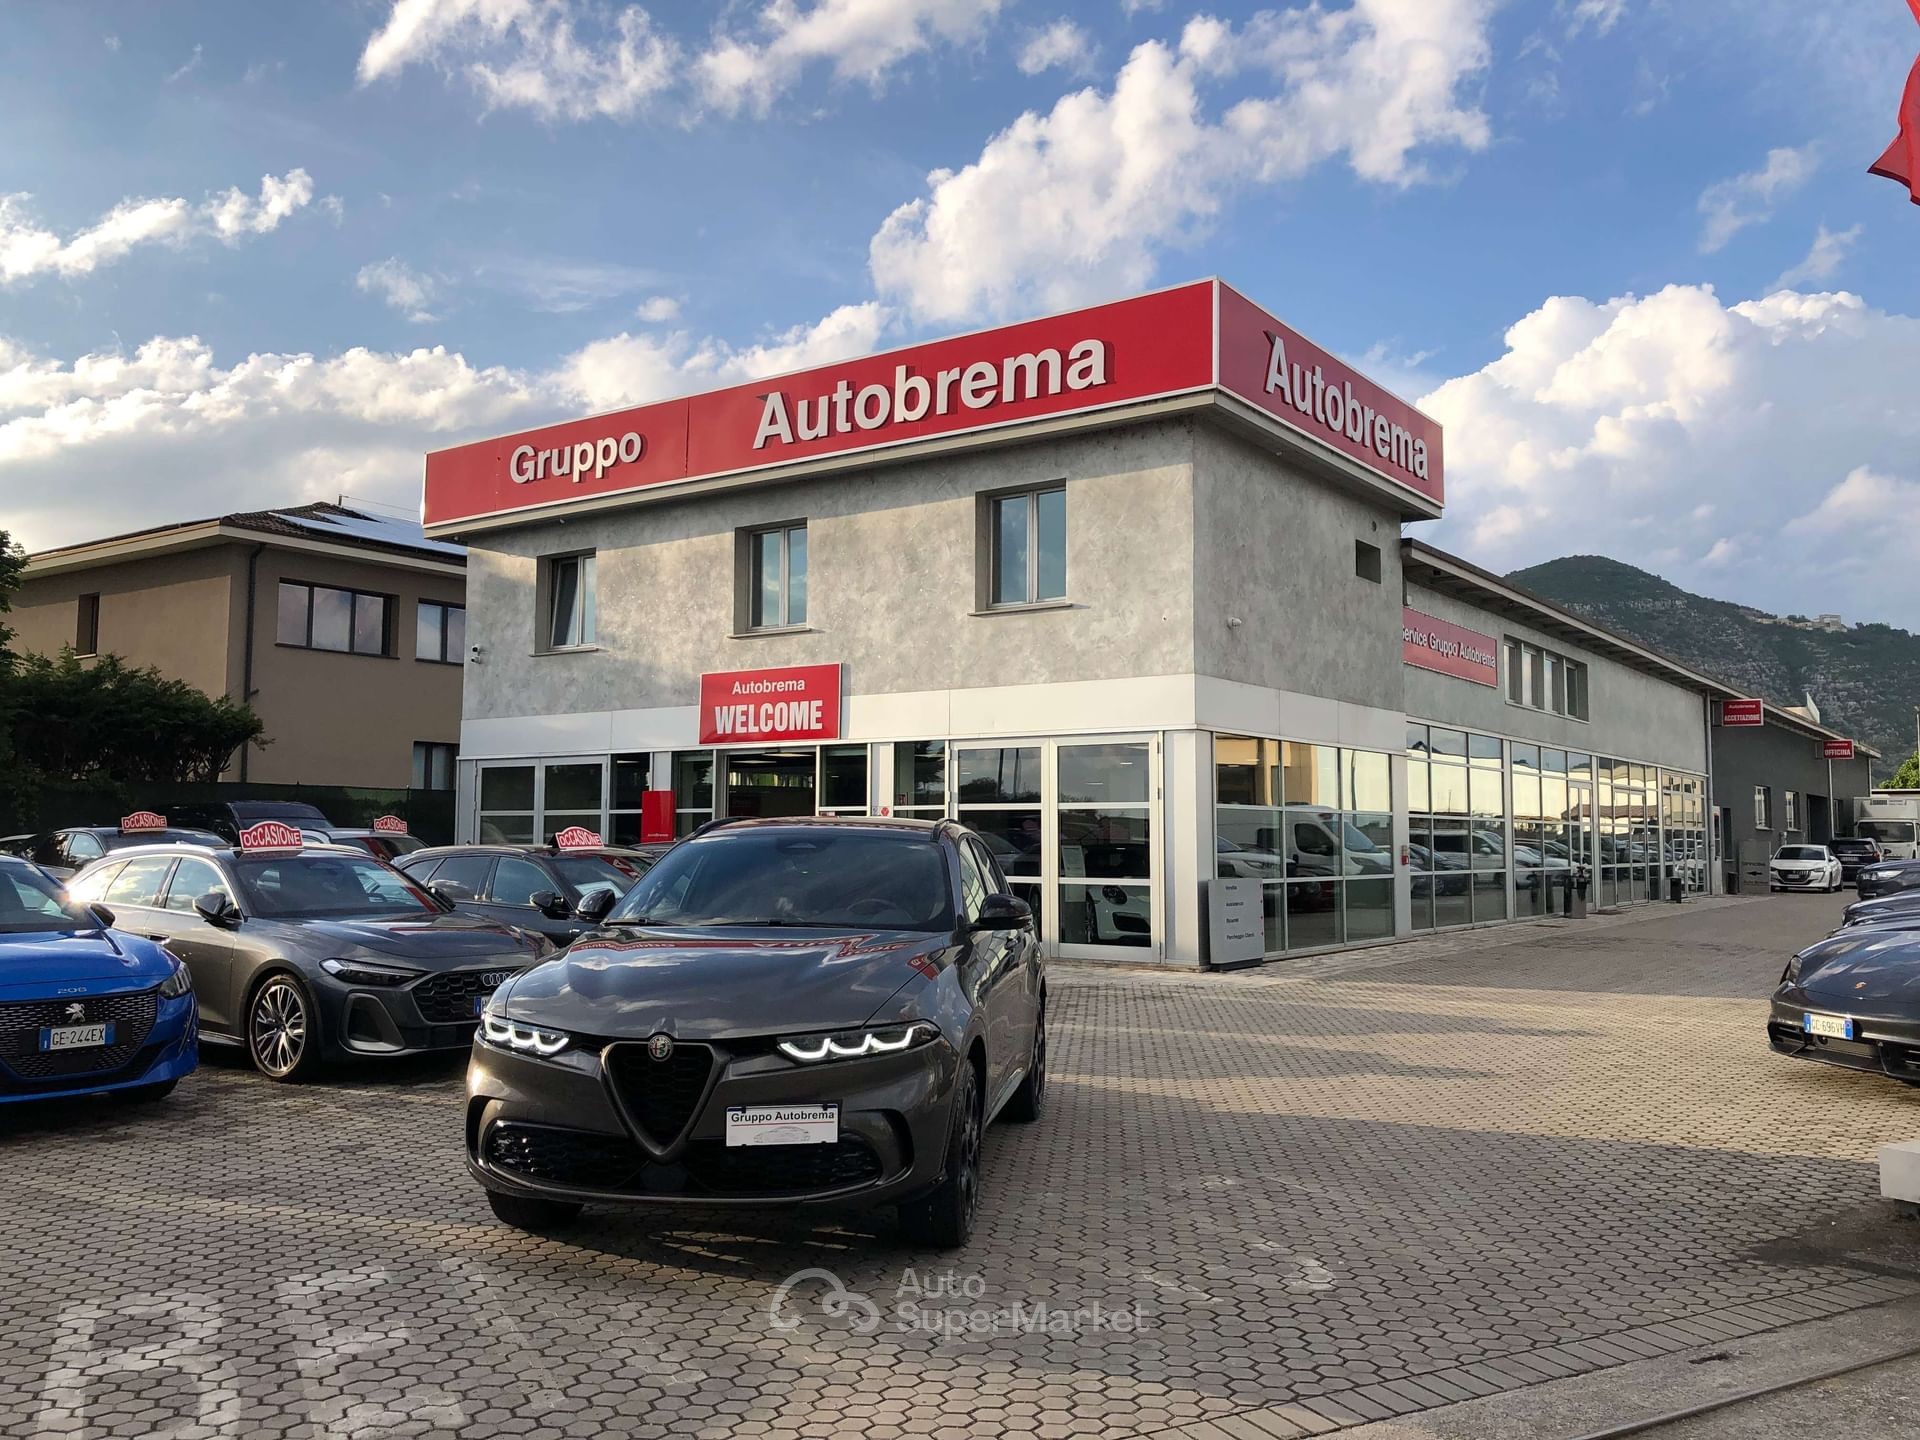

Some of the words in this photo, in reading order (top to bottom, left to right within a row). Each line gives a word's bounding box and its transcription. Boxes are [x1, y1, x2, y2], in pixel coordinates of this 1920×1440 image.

[509, 431, 642, 484] Gruppo
[752, 338, 1106, 450] Autobrema
[1265, 335, 1430, 481] Autobrema
[1429, 632, 1458, 659] Gruppo
[1460, 642, 1496, 668] Autobrema
[732, 679, 806, 696] Autobrema
[714, 699, 824, 735] WELCOME
[1824, 748, 1852, 756] OFFICINA
[124, 814, 167, 828] OCCASIONE
[375, 817, 408, 832] OCCASIONE
[243, 823, 302, 846] OCCASIONE
[559, 829, 603, 847] OCCASIONE
[731, 1113, 773, 1125] Gruppo
[774, 1110, 835, 1122] Autobrema
